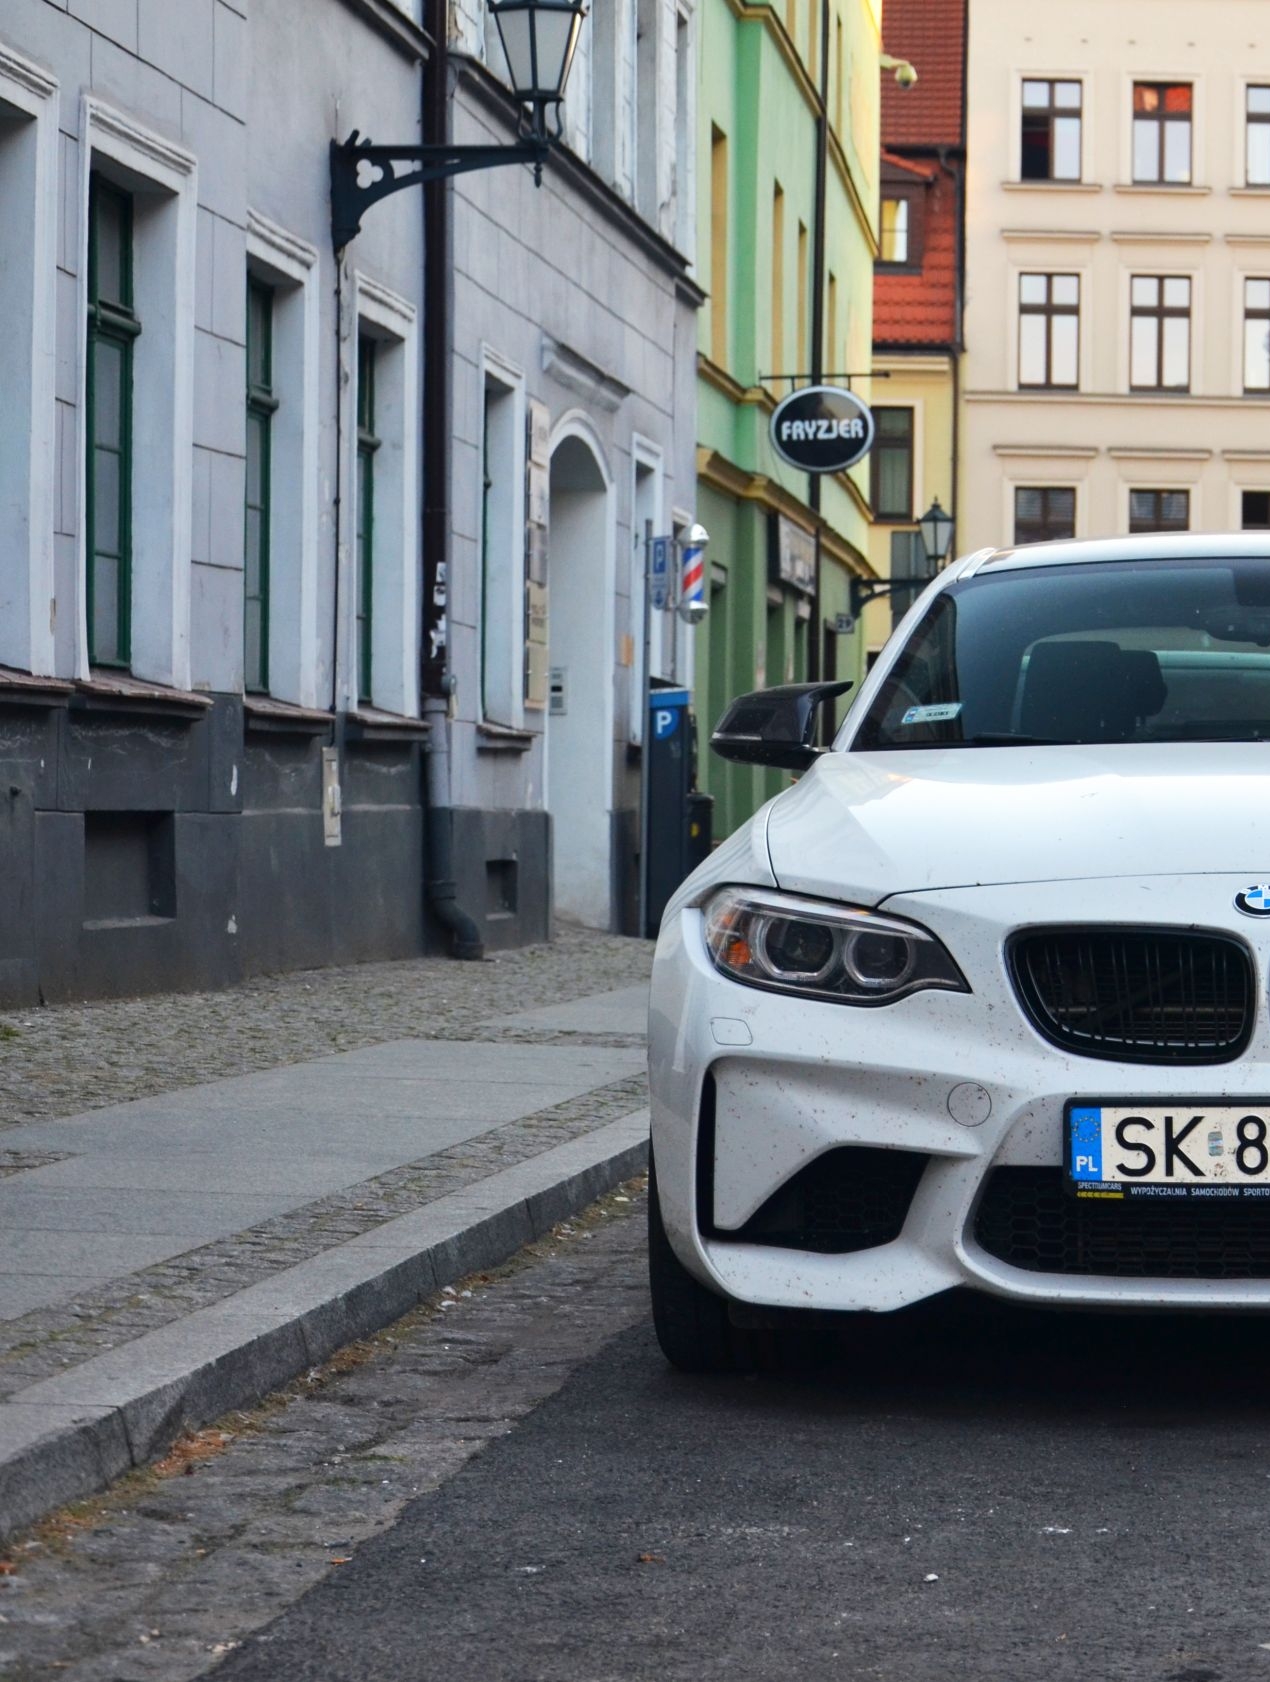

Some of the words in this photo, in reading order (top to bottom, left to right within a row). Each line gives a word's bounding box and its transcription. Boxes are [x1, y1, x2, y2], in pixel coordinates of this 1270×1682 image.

[781, 418, 864, 441] FRYZJER
[657, 711, 672, 734] P
[1115, 1116, 1207, 1177] SK
[1076, 1155, 1099, 1172] PL
[1131, 1185, 1187, 1197] WYPOŻYCZALNIA
[1191, 1187, 1239, 1198] SAMOCHODÓW
